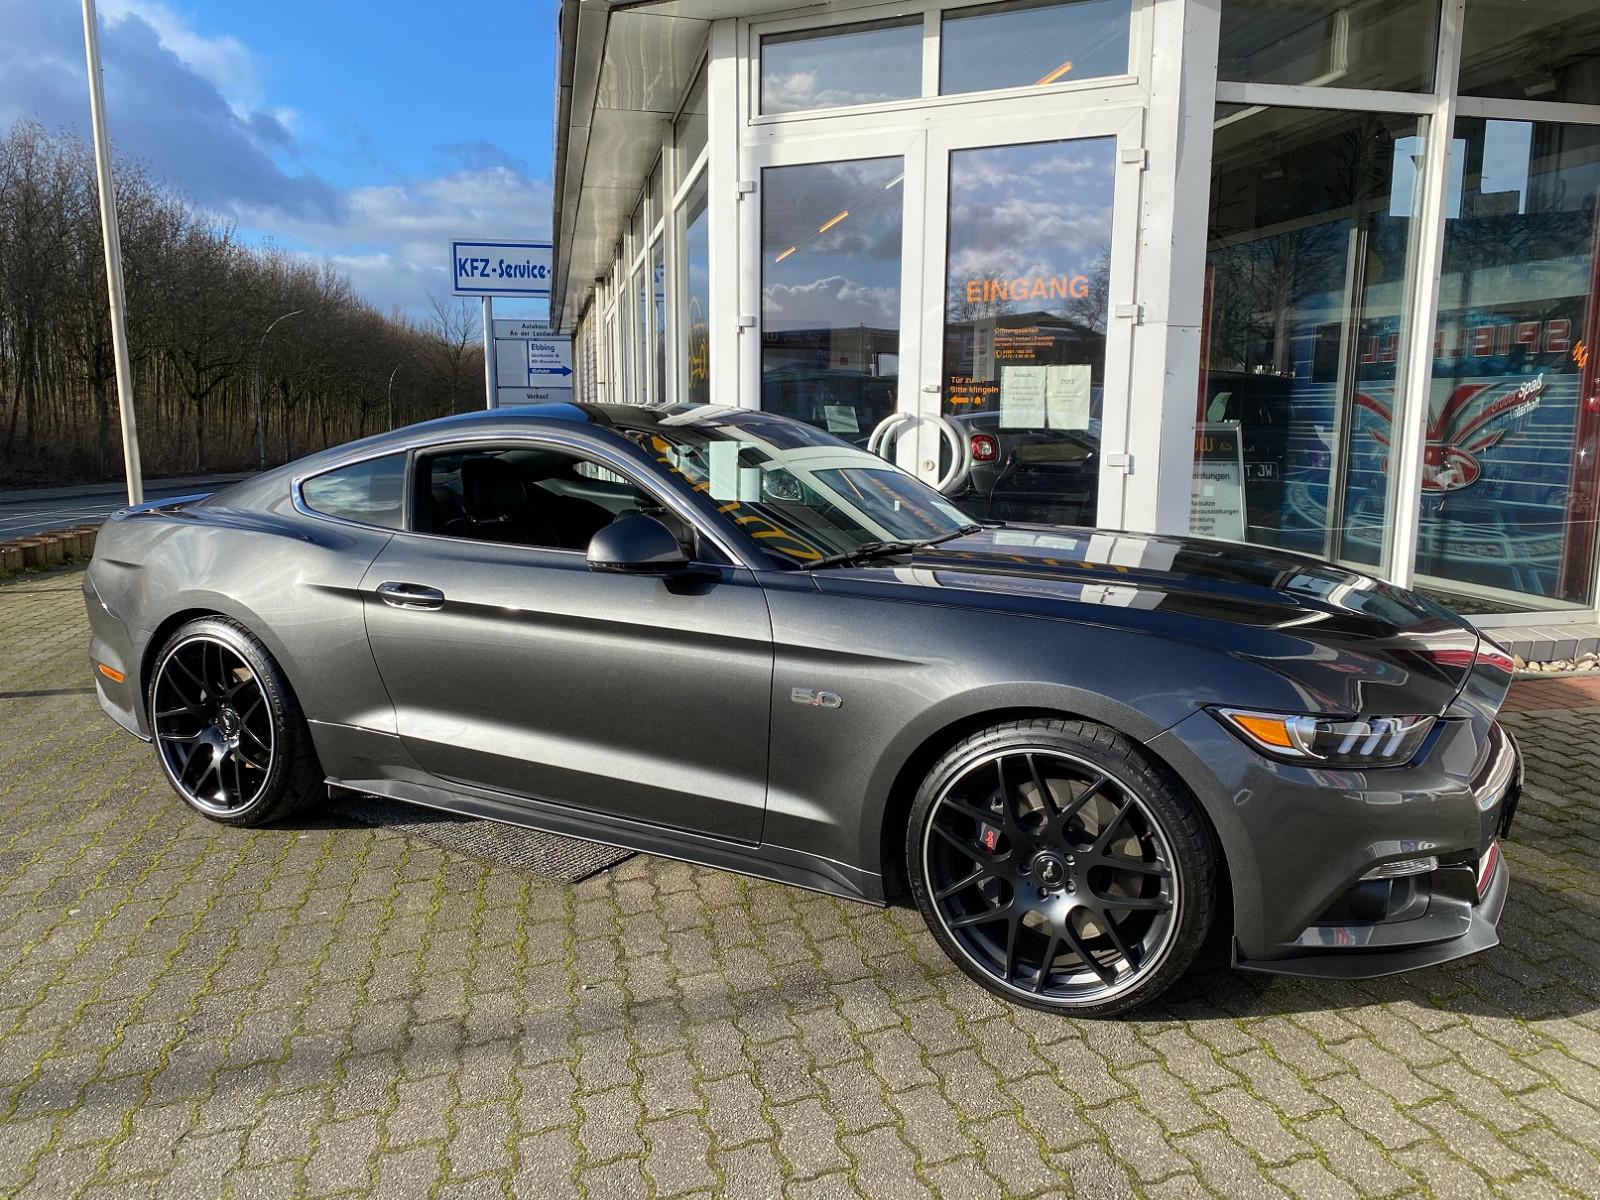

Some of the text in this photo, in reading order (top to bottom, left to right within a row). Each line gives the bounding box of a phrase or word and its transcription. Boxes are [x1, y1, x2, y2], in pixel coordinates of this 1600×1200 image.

[966, 274, 1089, 304] EINGANG
[531, 343, 556, 353] Ebbing
[951, 376, 963, 384] Tür
[950, 386, 999, 395] Bitte klingeln
[526, 392, 549, 400] Verkauf
[1192, 472, 1231, 482] eistungen
